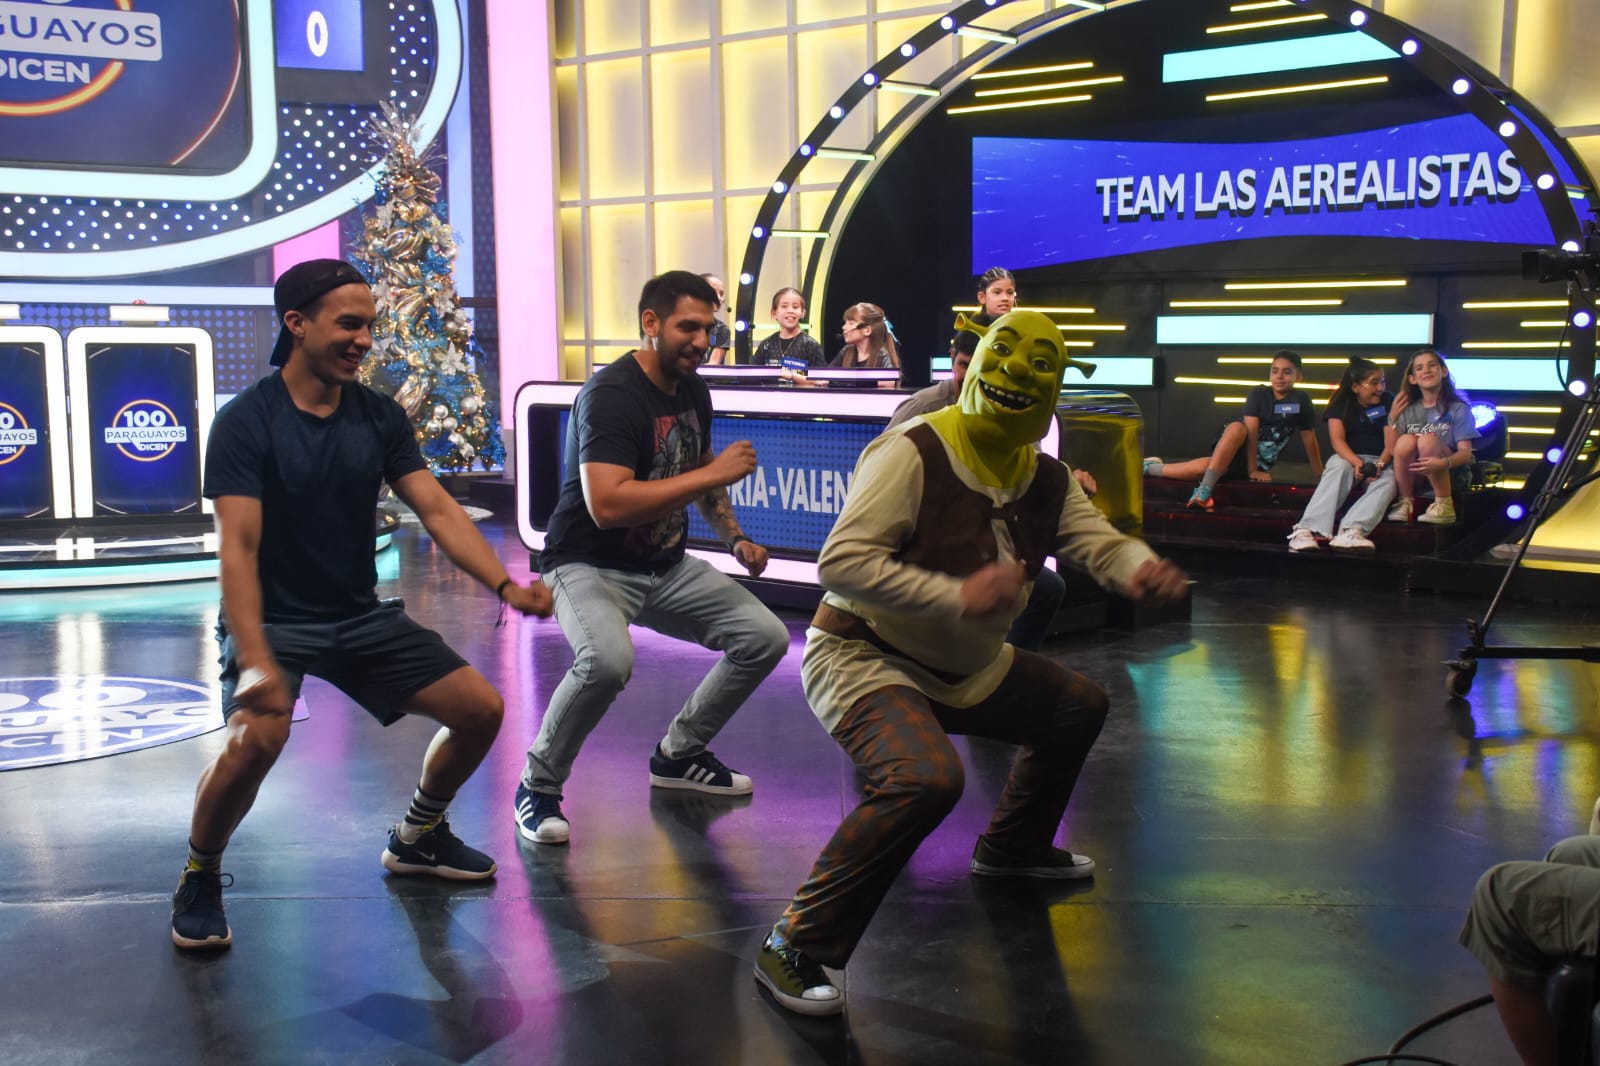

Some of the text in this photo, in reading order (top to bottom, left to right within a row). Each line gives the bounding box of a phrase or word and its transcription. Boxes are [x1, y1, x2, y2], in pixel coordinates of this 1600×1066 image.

[0, 14, 157, 48] UAYOS
[305, 10, 329, 58] 0
[1096, 149, 1521, 217] TEAM LAS AEREALISTAS
[123, 410, 167, 427] 100
[0, 432, 36, 441] AYOS
[106, 430, 185, 439] PARAGUAYOS
[139, 443, 168, 451] DICEN
[727, 466, 854, 514] RIA-VALEN
